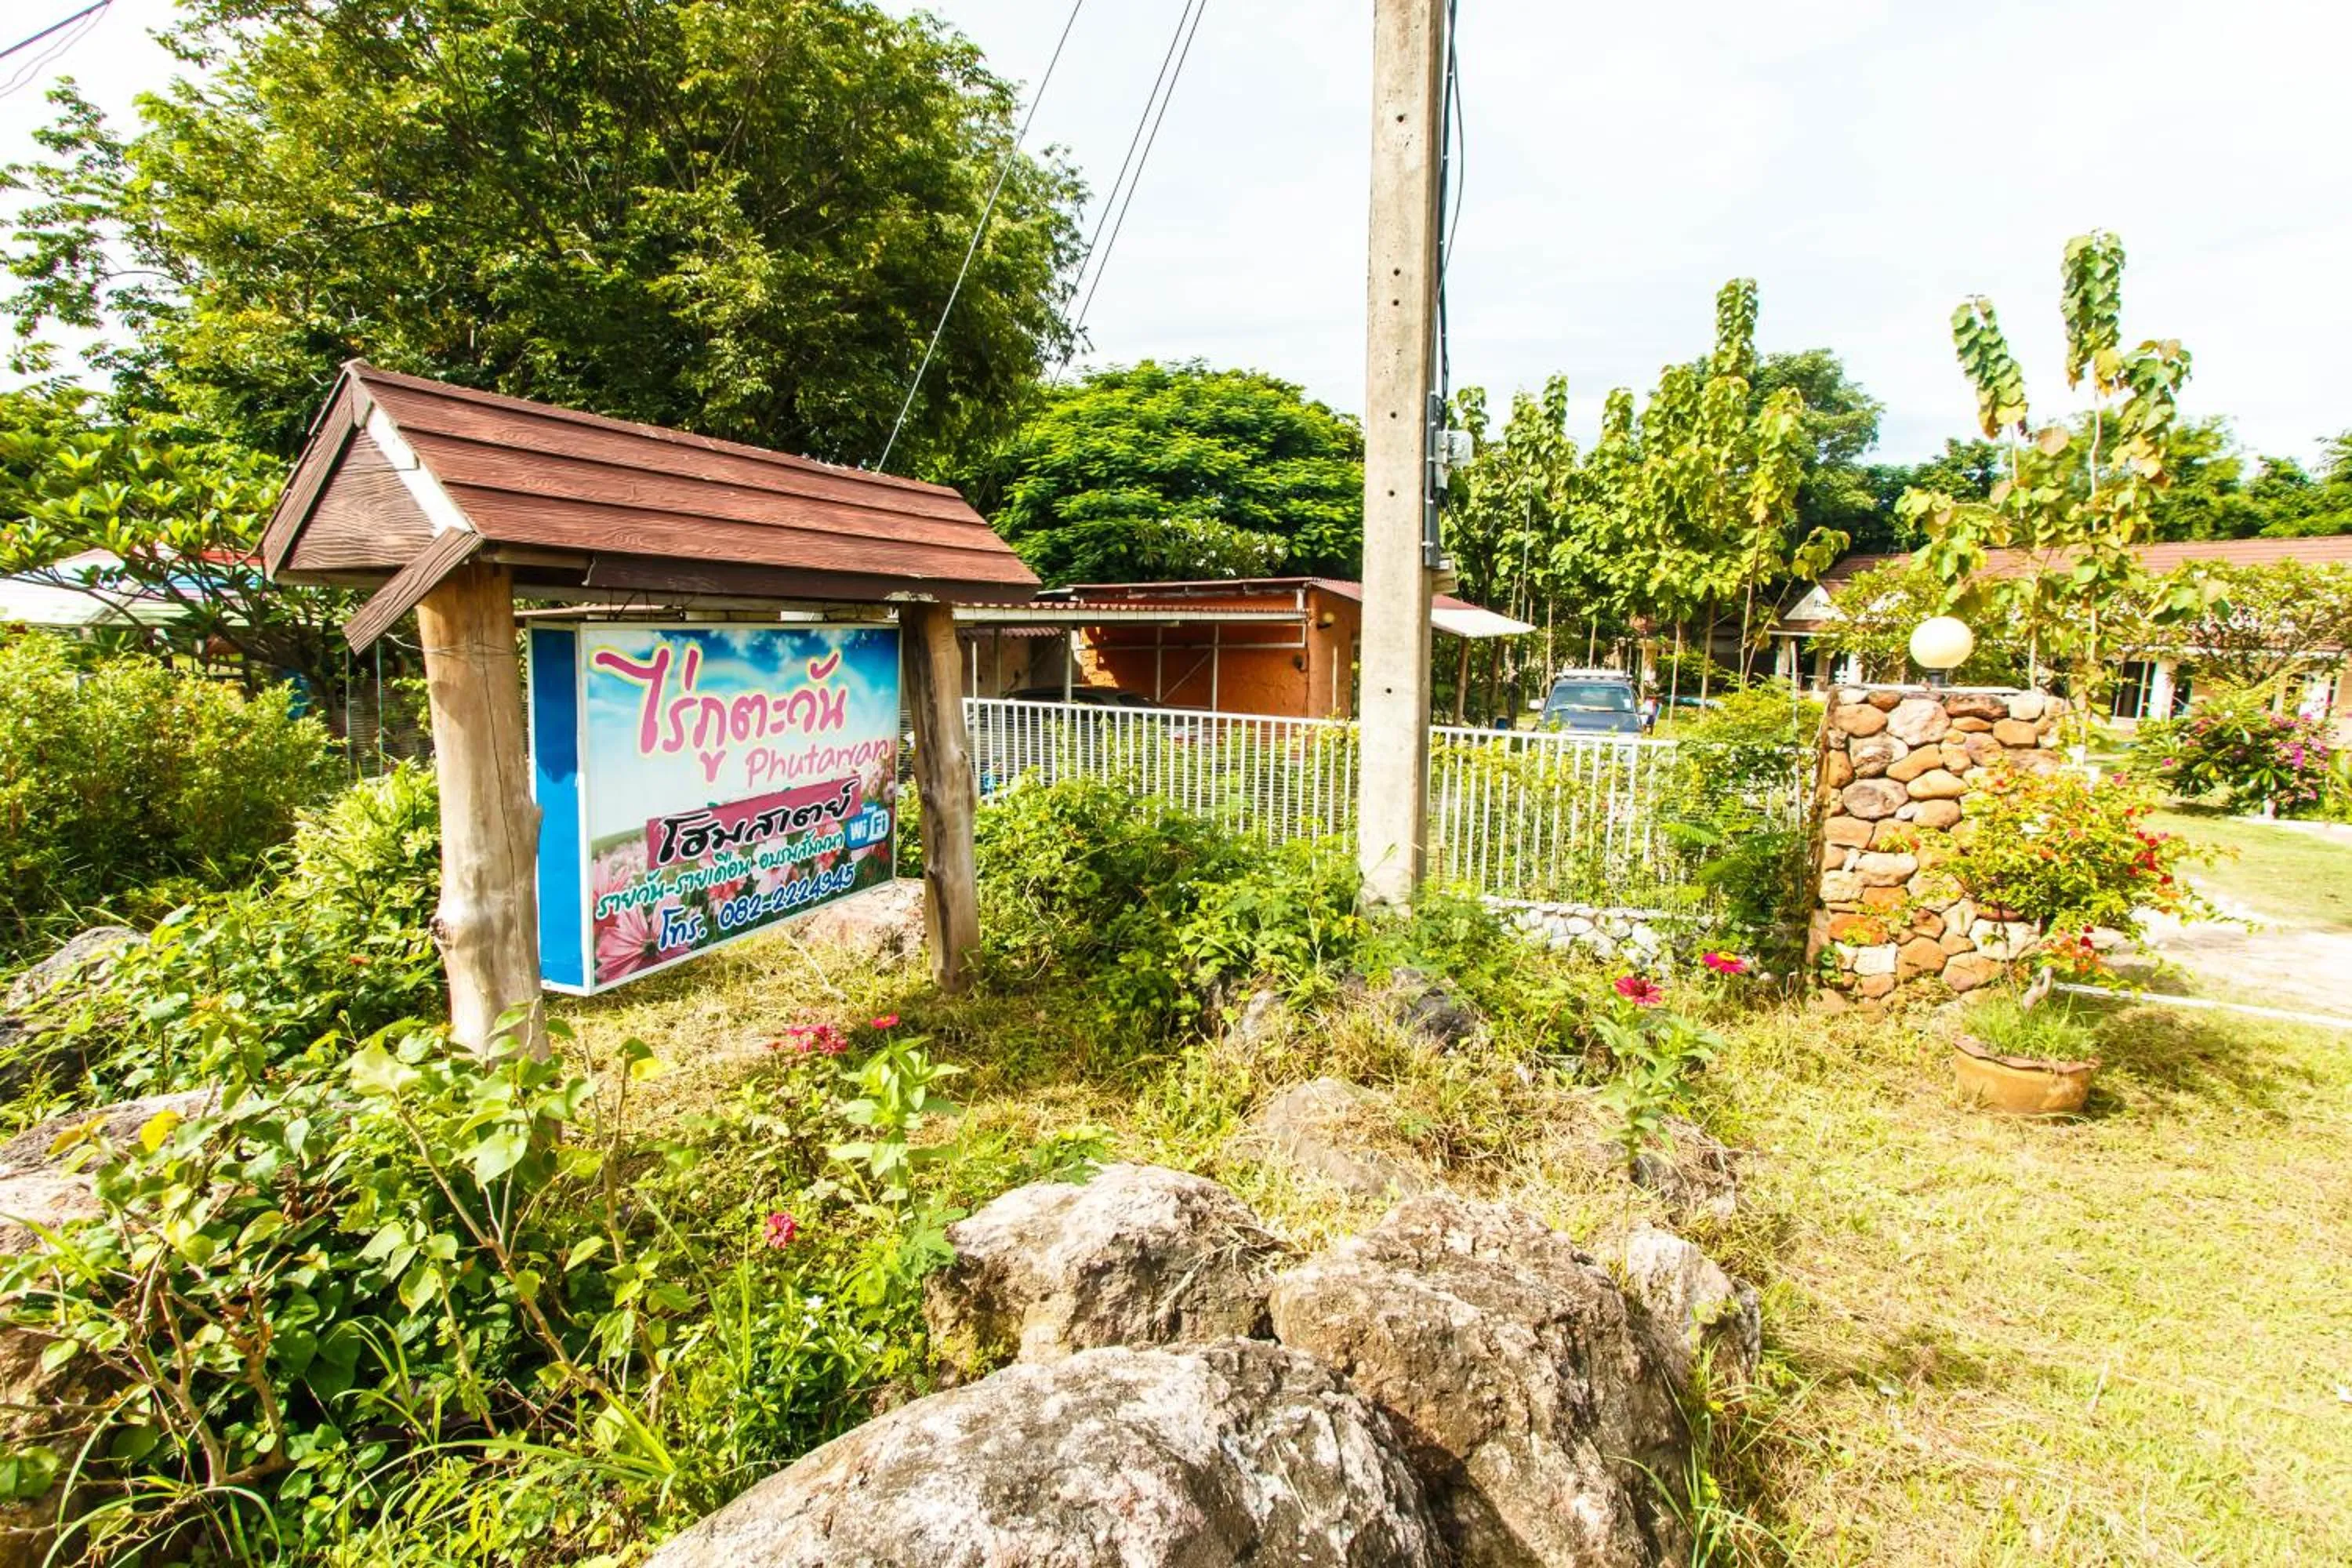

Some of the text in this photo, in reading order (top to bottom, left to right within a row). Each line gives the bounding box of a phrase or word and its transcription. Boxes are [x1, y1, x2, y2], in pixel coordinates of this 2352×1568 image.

[594, 648, 847, 782] ไร่ภูตะวัน
[746, 739, 888, 788] Phutawan
[659, 906, 706, 950] โทร.
